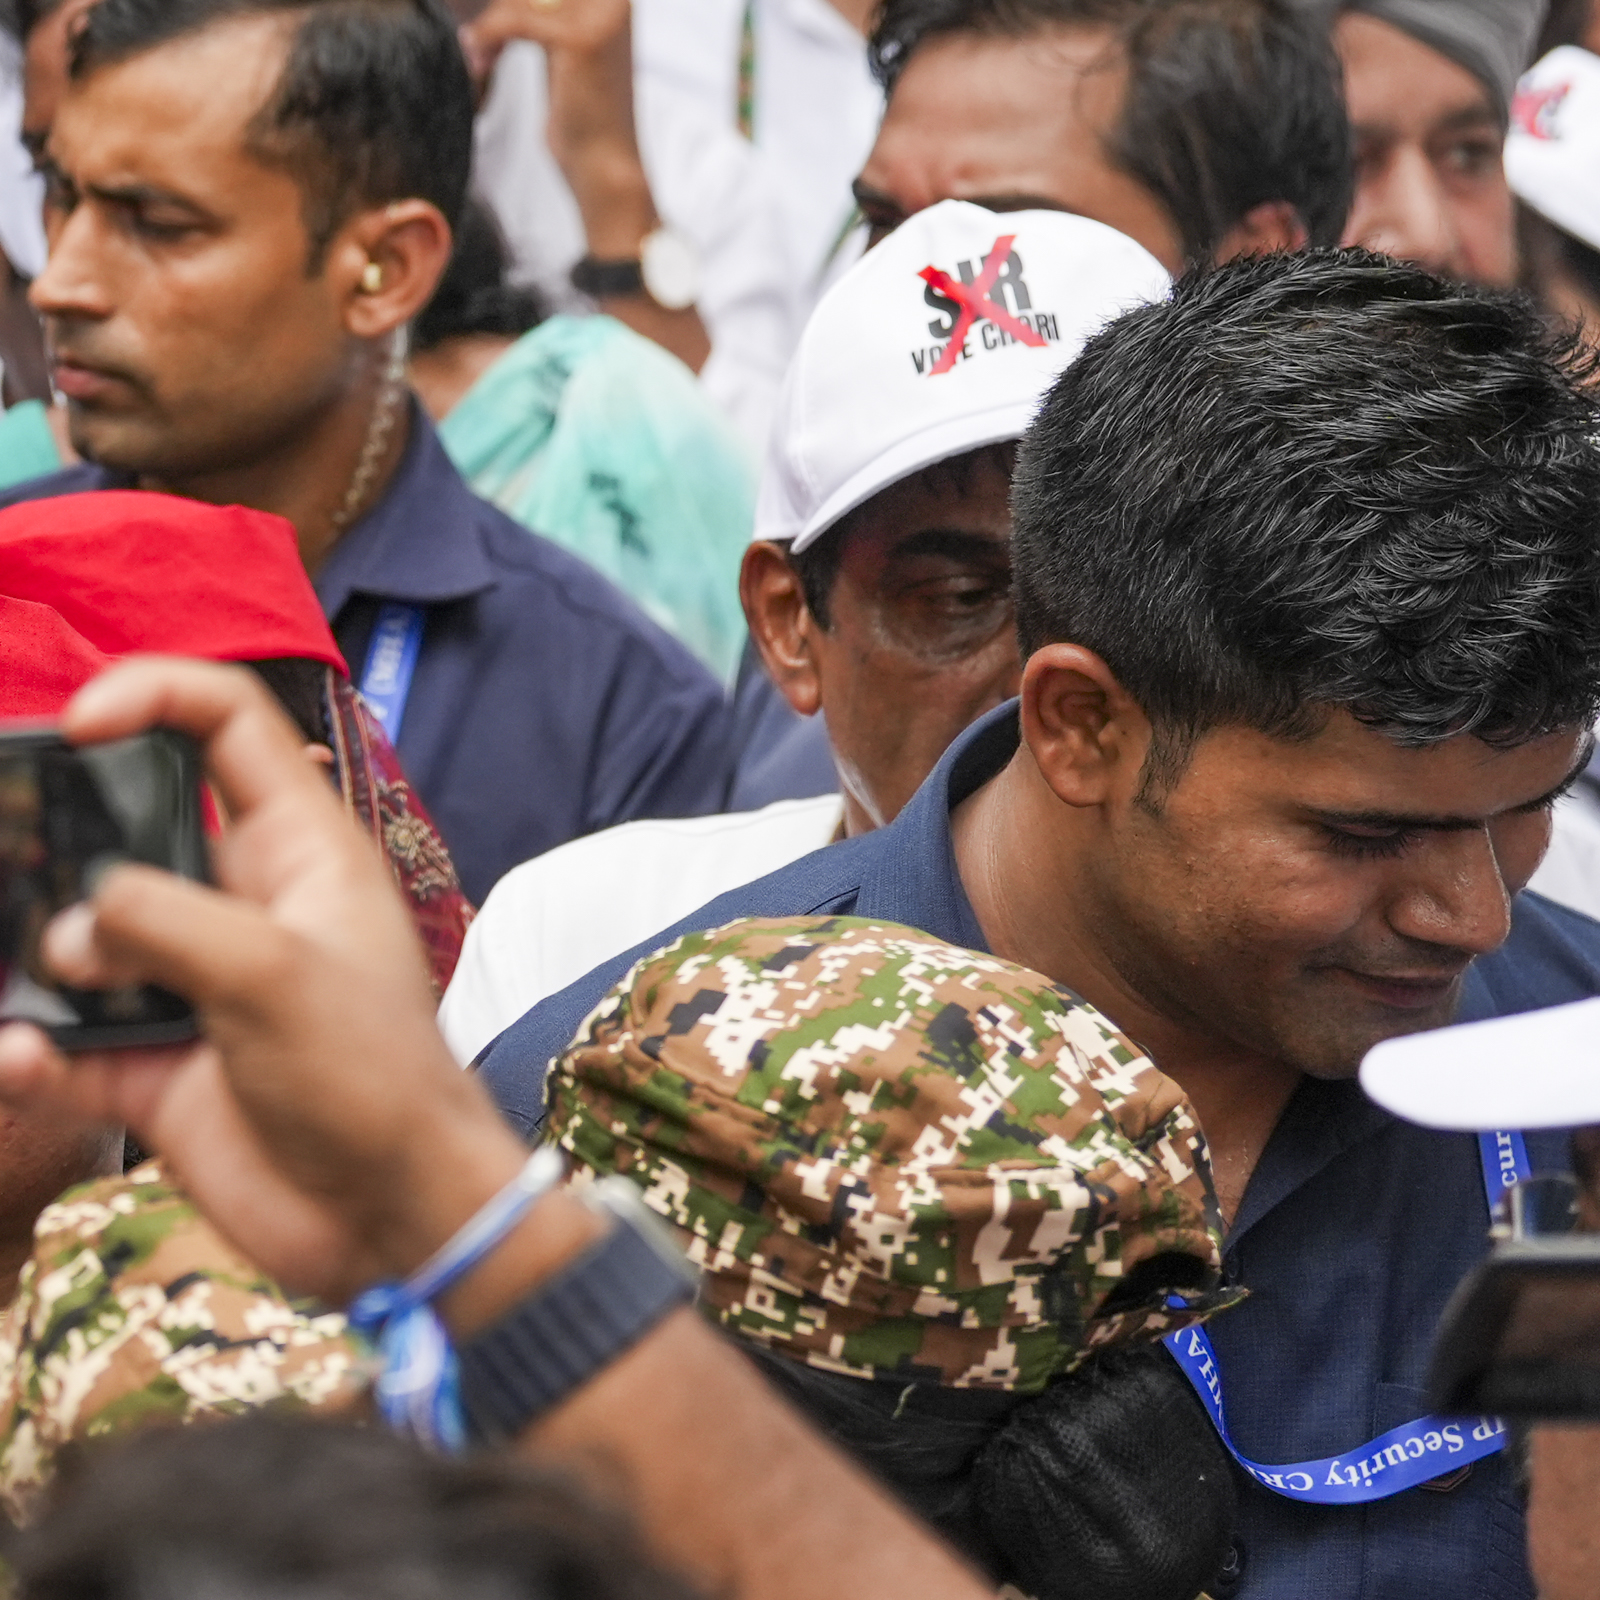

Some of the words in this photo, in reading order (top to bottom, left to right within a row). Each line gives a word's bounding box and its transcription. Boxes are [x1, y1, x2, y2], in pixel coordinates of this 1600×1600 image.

[922, 249, 1032, 340] SIR
[911, 341, 974, 376] VOE
[1323, 1421, 1465, 1488] Security
